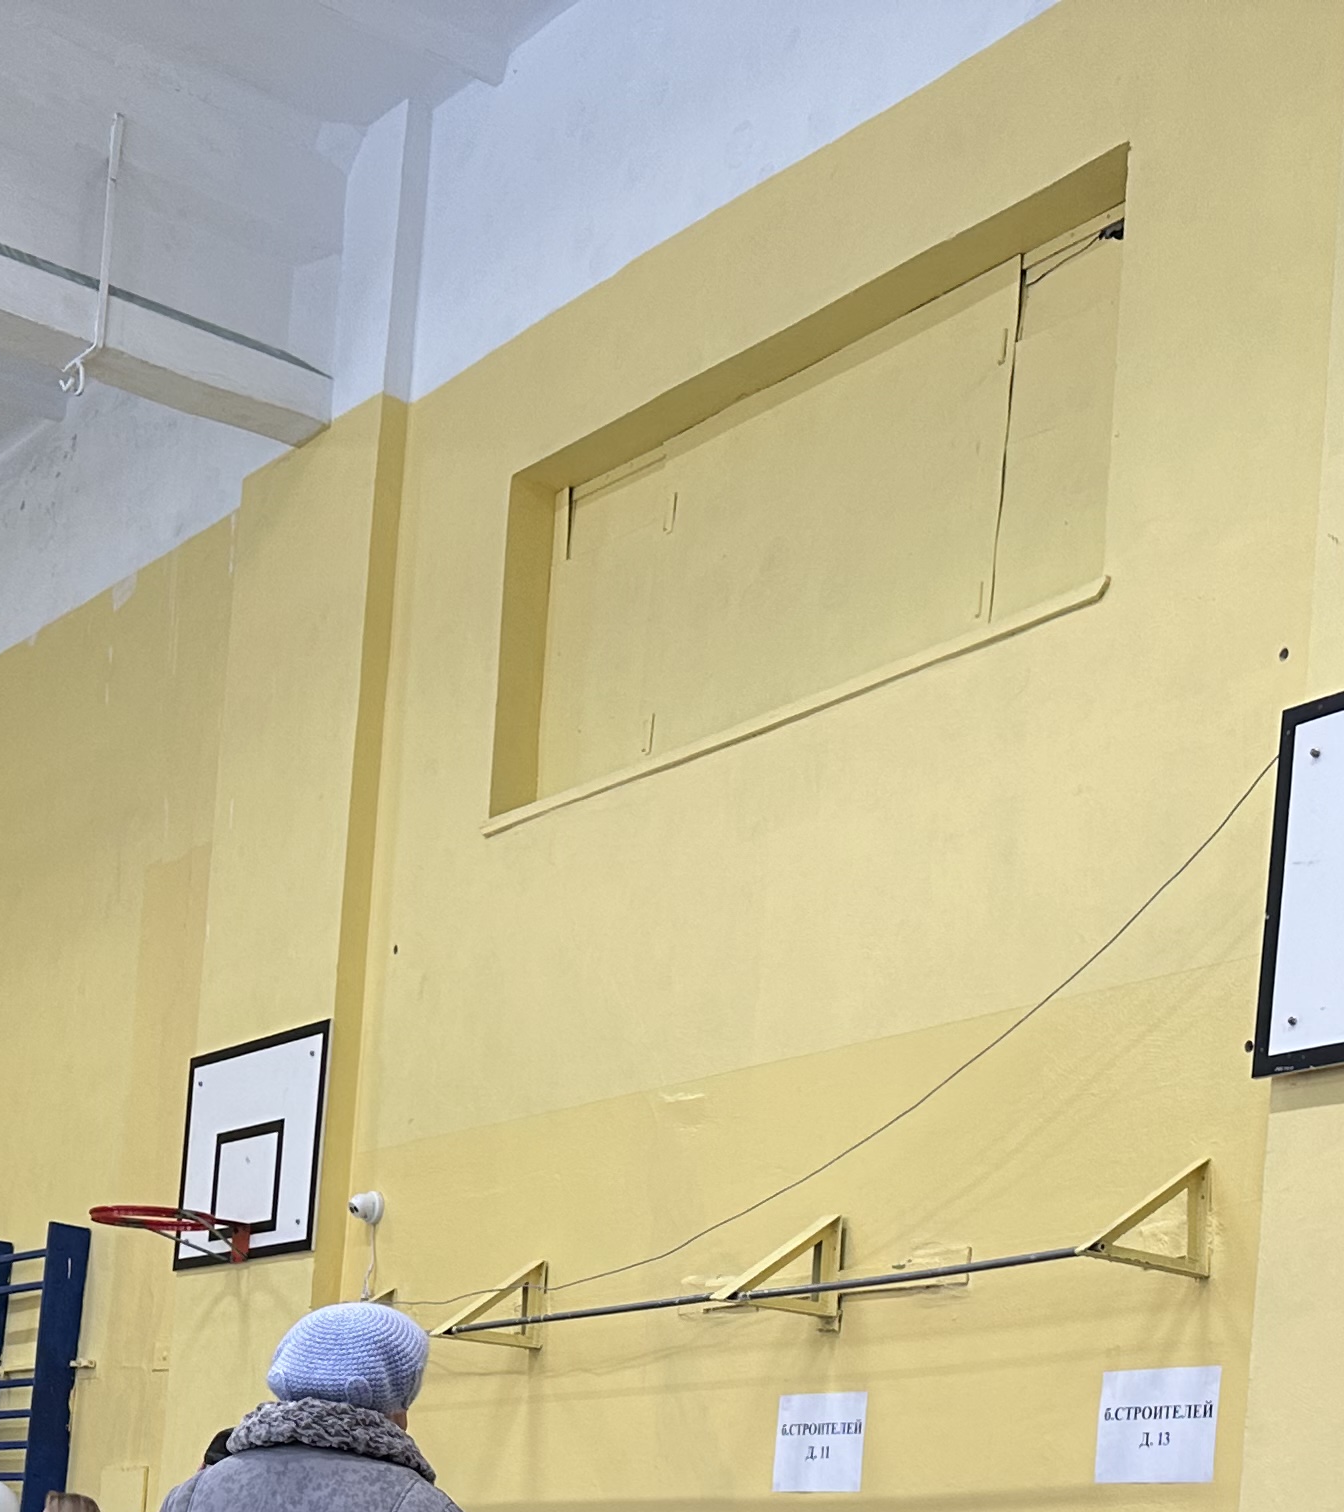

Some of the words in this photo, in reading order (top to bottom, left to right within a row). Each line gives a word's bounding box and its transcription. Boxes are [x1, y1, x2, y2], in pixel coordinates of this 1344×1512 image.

[1104, 1400, 1213, 1421] б.СТРОИТЕЛЕЙ
[1138, 1432, 1154, 1448] Д.
[1158, 1431, 1170, 1446] 13
[805, 1446, 817, 1461] Д.
[820, 1445, 830, 1459] 11
